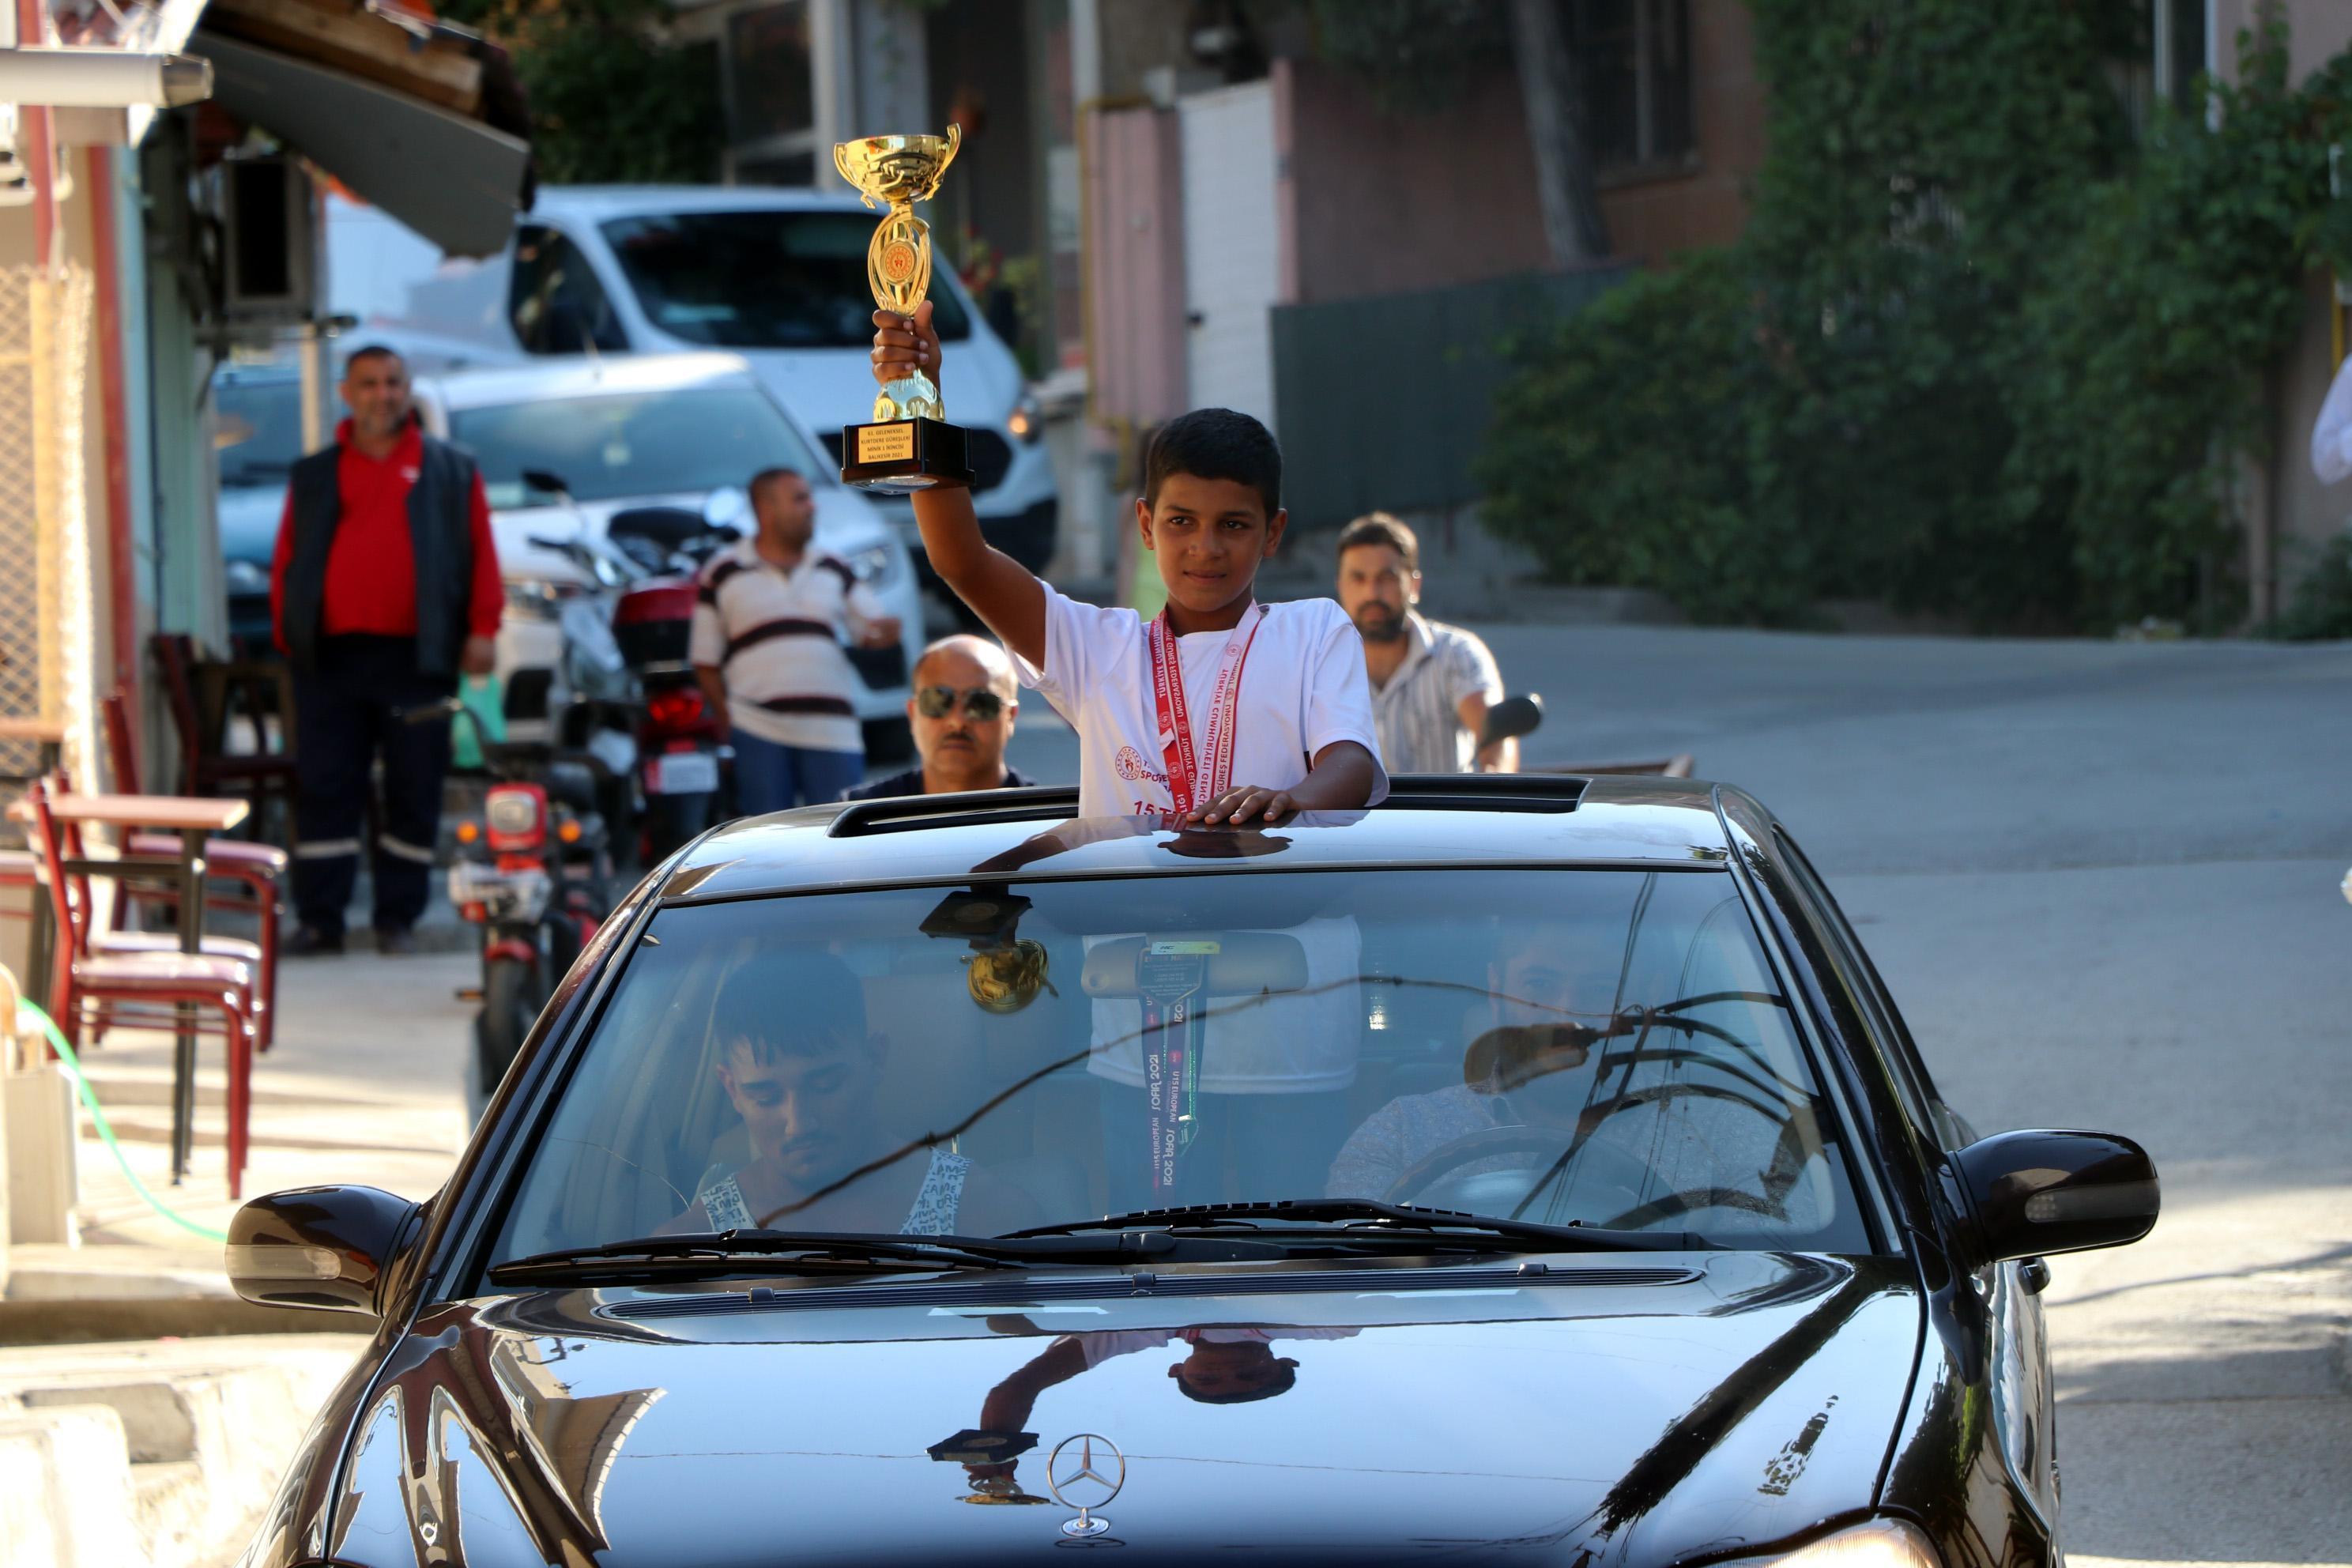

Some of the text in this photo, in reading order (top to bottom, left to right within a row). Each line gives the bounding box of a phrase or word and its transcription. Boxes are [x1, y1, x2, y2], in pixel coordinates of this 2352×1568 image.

[1217, 704, 1231, 792] GÜREŞ FEDERASYONU
[1149, 1054, 1159, 1080] 2021
[1170, 1086, 1178, 1122] EUROPEAN
[1163, 1160, 1173, 1185] 2021
